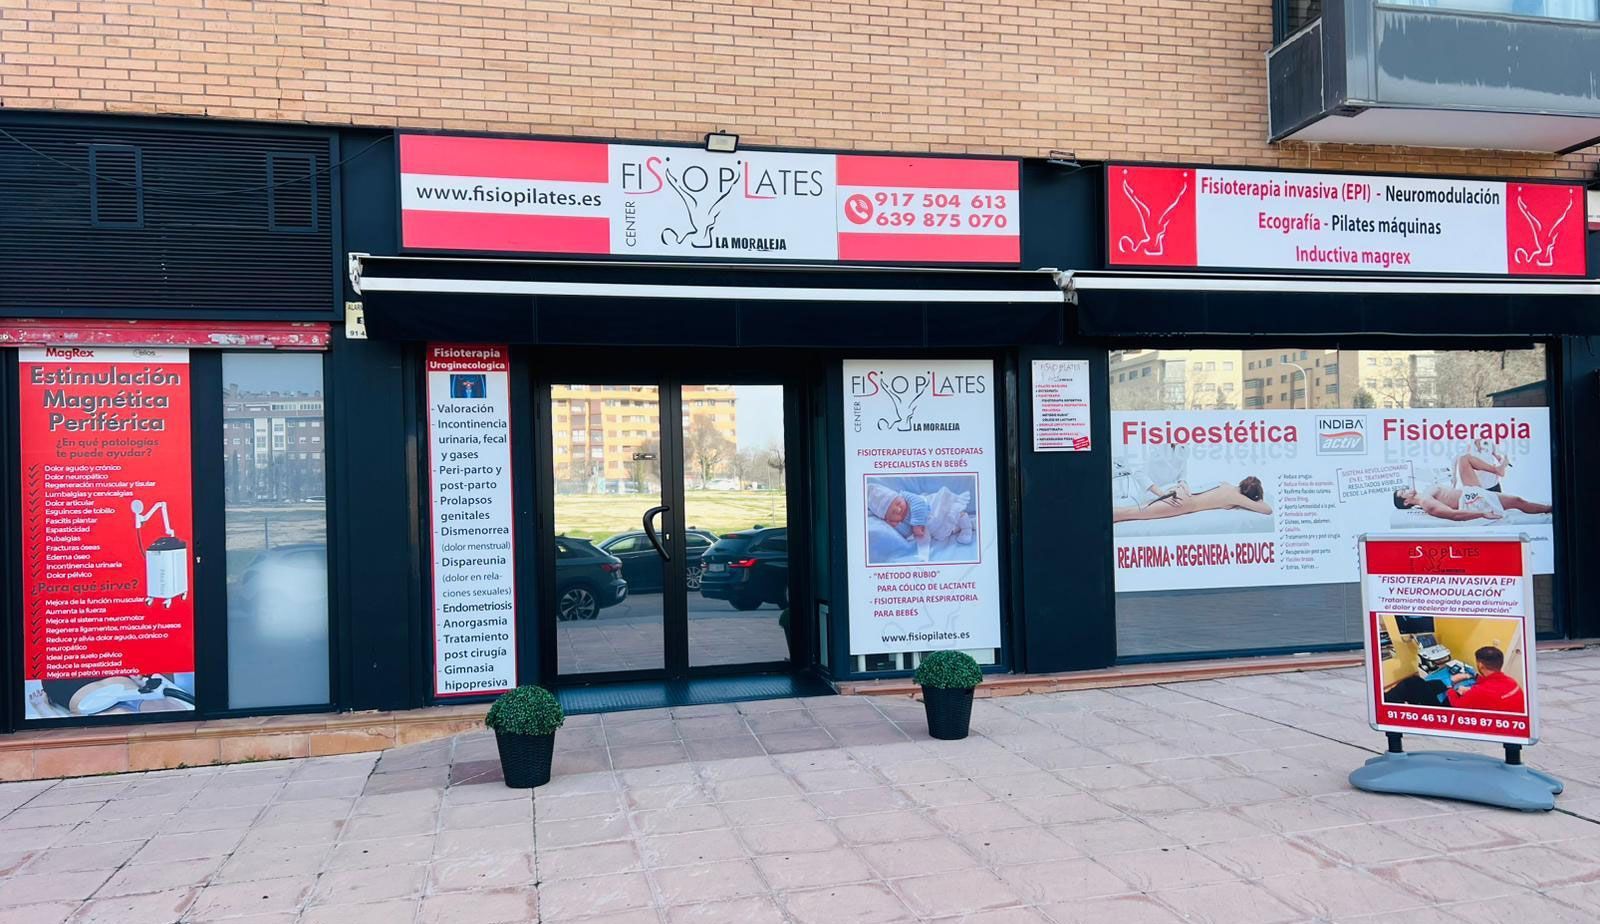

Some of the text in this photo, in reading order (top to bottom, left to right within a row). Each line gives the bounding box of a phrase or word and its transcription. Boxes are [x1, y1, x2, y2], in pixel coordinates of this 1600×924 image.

[417, 185, 602, 207] www.fisiopilates.es
[1201, 177, 1500, 206] Fisioterapia invasiva (EPI) Neuromodulación
[875, 192, 1006, 209] 917 504 613
[626, 201, 636, 247] CENTER
[876, 212, 1007, 228] 639 875 070
[1259, 211, 1442, 236] Ecografía Pilates máquinas
[716, 237, 786, 250] LA MORALEJA
[1296, 245, 1411, 266] Inductiva magrex
[46, 347, 94, 359] MagRex
[434, 348, 500, 359] Fisioterapia
[430, 361, 506, 371] Uroginecologica
[31, 366, 181, 386] Estimulación
[43, 389, 169, 413] Magnética
[437, 404, 494, 413] Valoración
[50, 413, 165, 432] Periférica
[438, 419, 507, 429] Incontinencia
[913, 423, 960, 431] LA MORALEJA
[1319, 419, 1363, 429] INDIBA
[1122, 420, 1298, 445] Fisioestética
[1383, 417, 1531, 444] Fisioterapia
[56, 437, 159, 449] ¿En qué patologías
[439, 434, 507, 445] urinaria, fecal
[1322, 437, 1361, 449] activ
[70, 449, 105, 459] puede
[107, 449, 152, 459] ayudar?
[441, 451, 479, 462] y gases
[857, 448, 927, 456] FISIOTERAPEUTAS
[935, 447, 983, 455] OSTEOPATAS
[874, 460, 930, 468] ESPECIALISTAS
[944, 458, 968, 467] BEBÉS
[439, 466, 502, 478] Peri-parto y
[1341, 464, 1409, 477] SISTEMA REVOLUCIONARIO
[1364, 472, 1400, 481] TRATAMIENTO
[66, 473, 108, 481] neuropático
[440, 481, 497, 492] post-parto
[1348, 480, 1380, 489] RESULTADOS
[1342, 490, 1359, 498] DESDE
[1368, 487, 1390, 495] PRIMERA
[440, 496, 492, 508] Prolapsos
[440, 511, 490, 523] genitales
[46, 526, 90, 534] Espasticidad
[441, 526, 509, 536] Dismenorrea
[442, 541, 511, 552] (dolor menstrual)
[442, 556, 506, 568] Dispareunia
[442, 573, 469, 583] (dolor
[483, 572, 503, 581] rela-
[1448, 577, 1498, 586] INVASIVA
[1500, 577, 1515, 586] EPI
[31, 579, 138, 596] ¿Para qué sirve?
[442, 586, 512, 598] ciones sexuales)
[877, 584, 897, 592] PARA
[898, 582, 926, 591] CÓLICO
[939, 582, 976, 590] LACTANTE
[874, 594, 978, 605] FISIOTERAPIA RESPIRATORIA
[443, 602, 512, 613] Endometriosis
[895, 608, 919, 616] BEBÉS
[443, 616, 508, 630] Anorgasmia
[444, 632, 509, 644] Tratamiento
[881, 631, 970, 643] www.fisiopilates.es
[444, 648, 507, 661] post cirugía
[80, 661, 122, 669] espasticidad
[444, 663, 494, 674] Gimnasia
[445, 677, 508, 691] hipopresiva
[1387, 711, 1525, 729] 91 750 46 13 639 87 50 70
